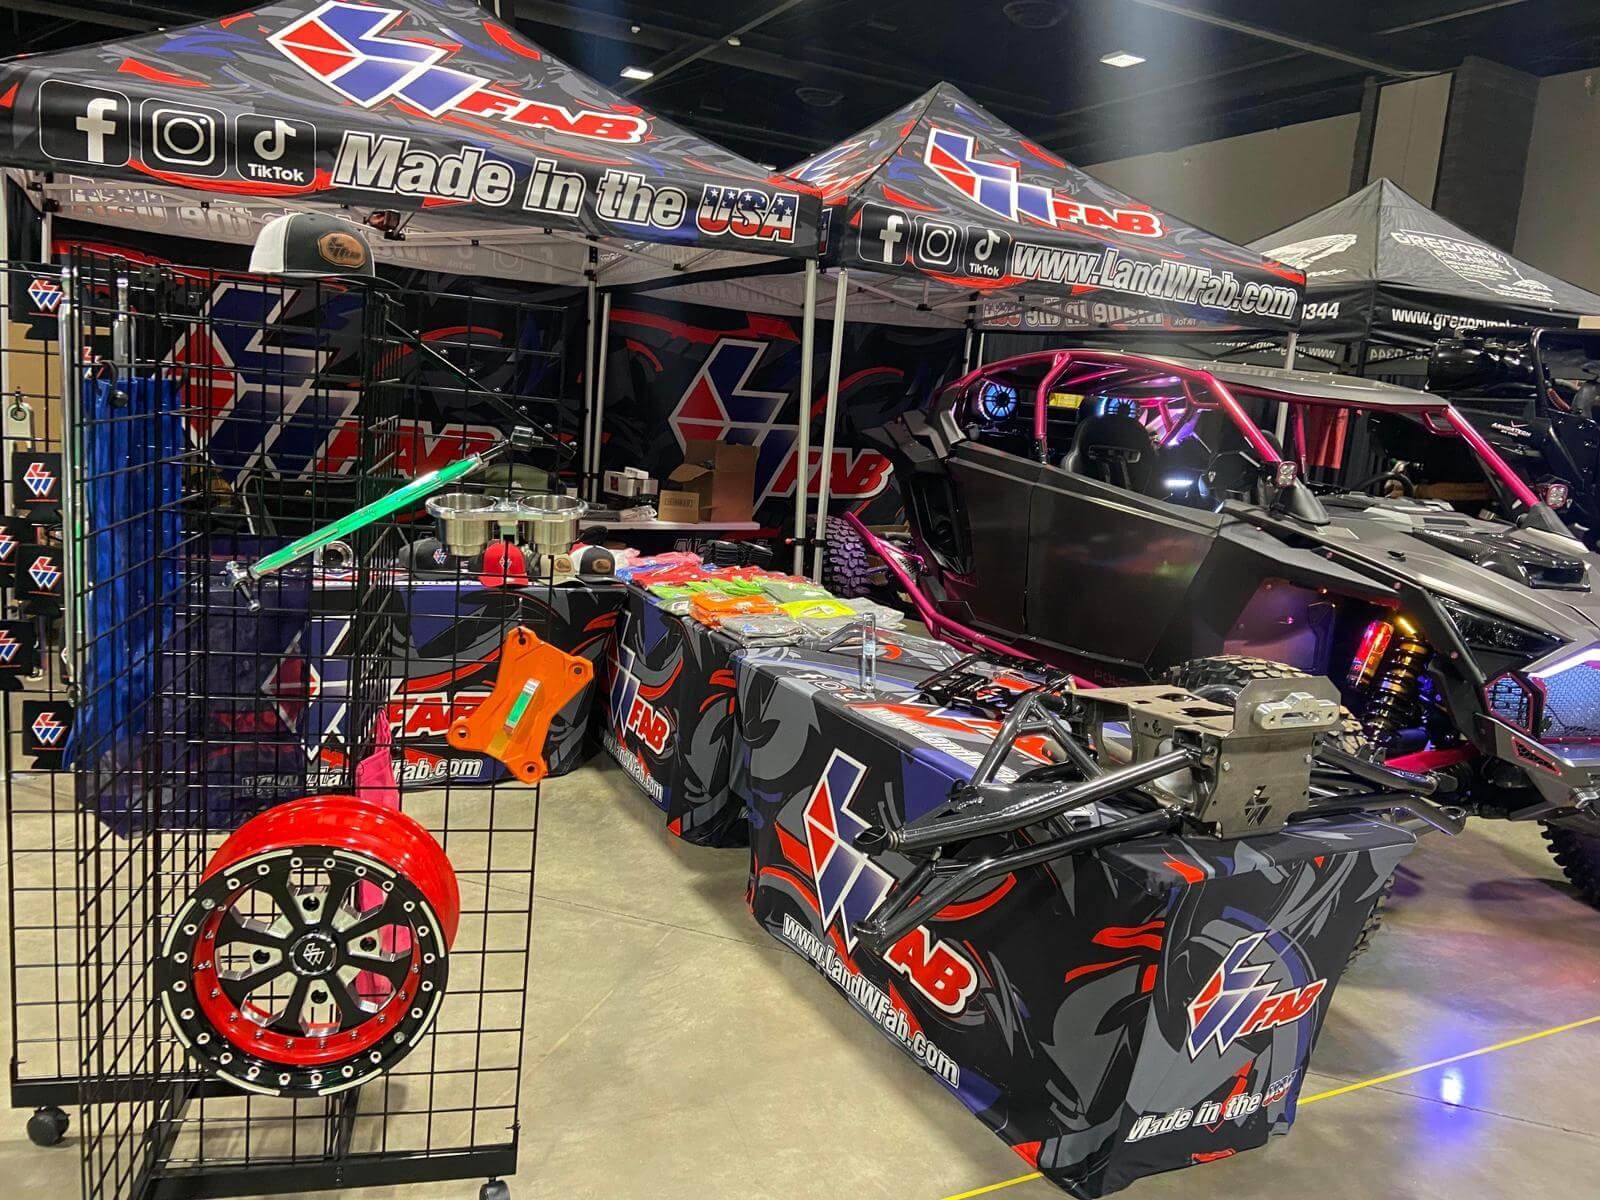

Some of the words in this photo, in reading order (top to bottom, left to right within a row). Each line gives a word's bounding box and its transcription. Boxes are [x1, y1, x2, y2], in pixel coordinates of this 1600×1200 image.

[452, 89, 648, 144] FAB
[247, 162, 305, 183] TikTok
[331, 129, 515, 206] Made
[522, 156, 587, 217] in
[595, 168, 687, 230] the
[696, 183, 800, 243] USA
[1053, 199, 1167, 238] FAB
[969, 262, 1000, 278] TikTok
[1010, 241, 1298, 318] www.LandWFab.com
[766, 445, 894, 499] FAB
[626, 694, 671, 755] FAB
[883, 925, 980, 1015] AB
[782, 913, 961, 1089] www.LandWFab.com
[1239, 979, 1328, 1035] FAB
[1124, 1107, 1194, 1143] Made
[1192, 1100, 1222, 1127] in
[1223, 1092, 1263, 1120] the
